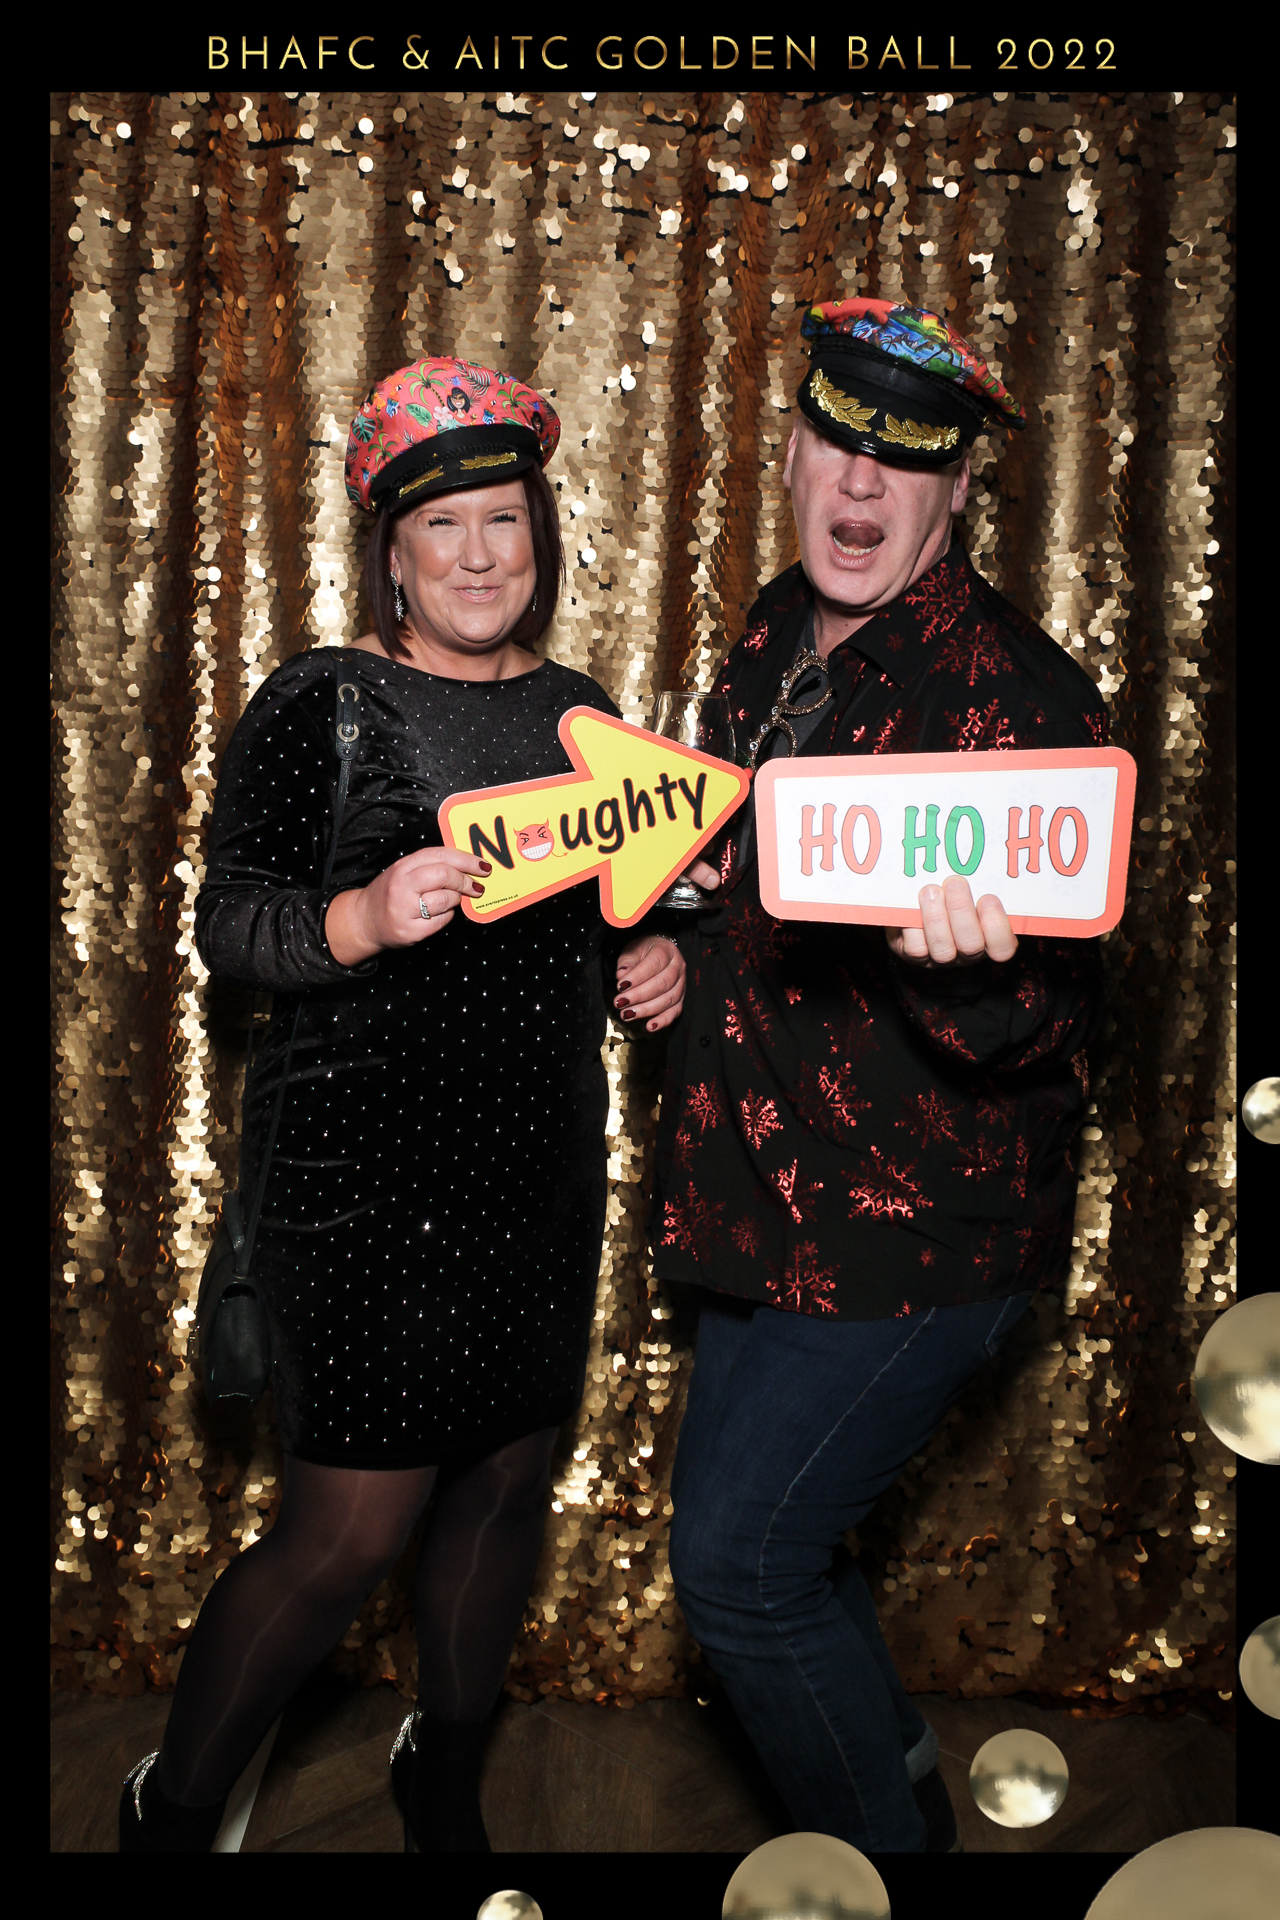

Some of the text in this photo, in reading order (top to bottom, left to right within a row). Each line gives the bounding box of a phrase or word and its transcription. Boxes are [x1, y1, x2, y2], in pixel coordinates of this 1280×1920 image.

[798, 803, 1089, 878] HO HO HO
